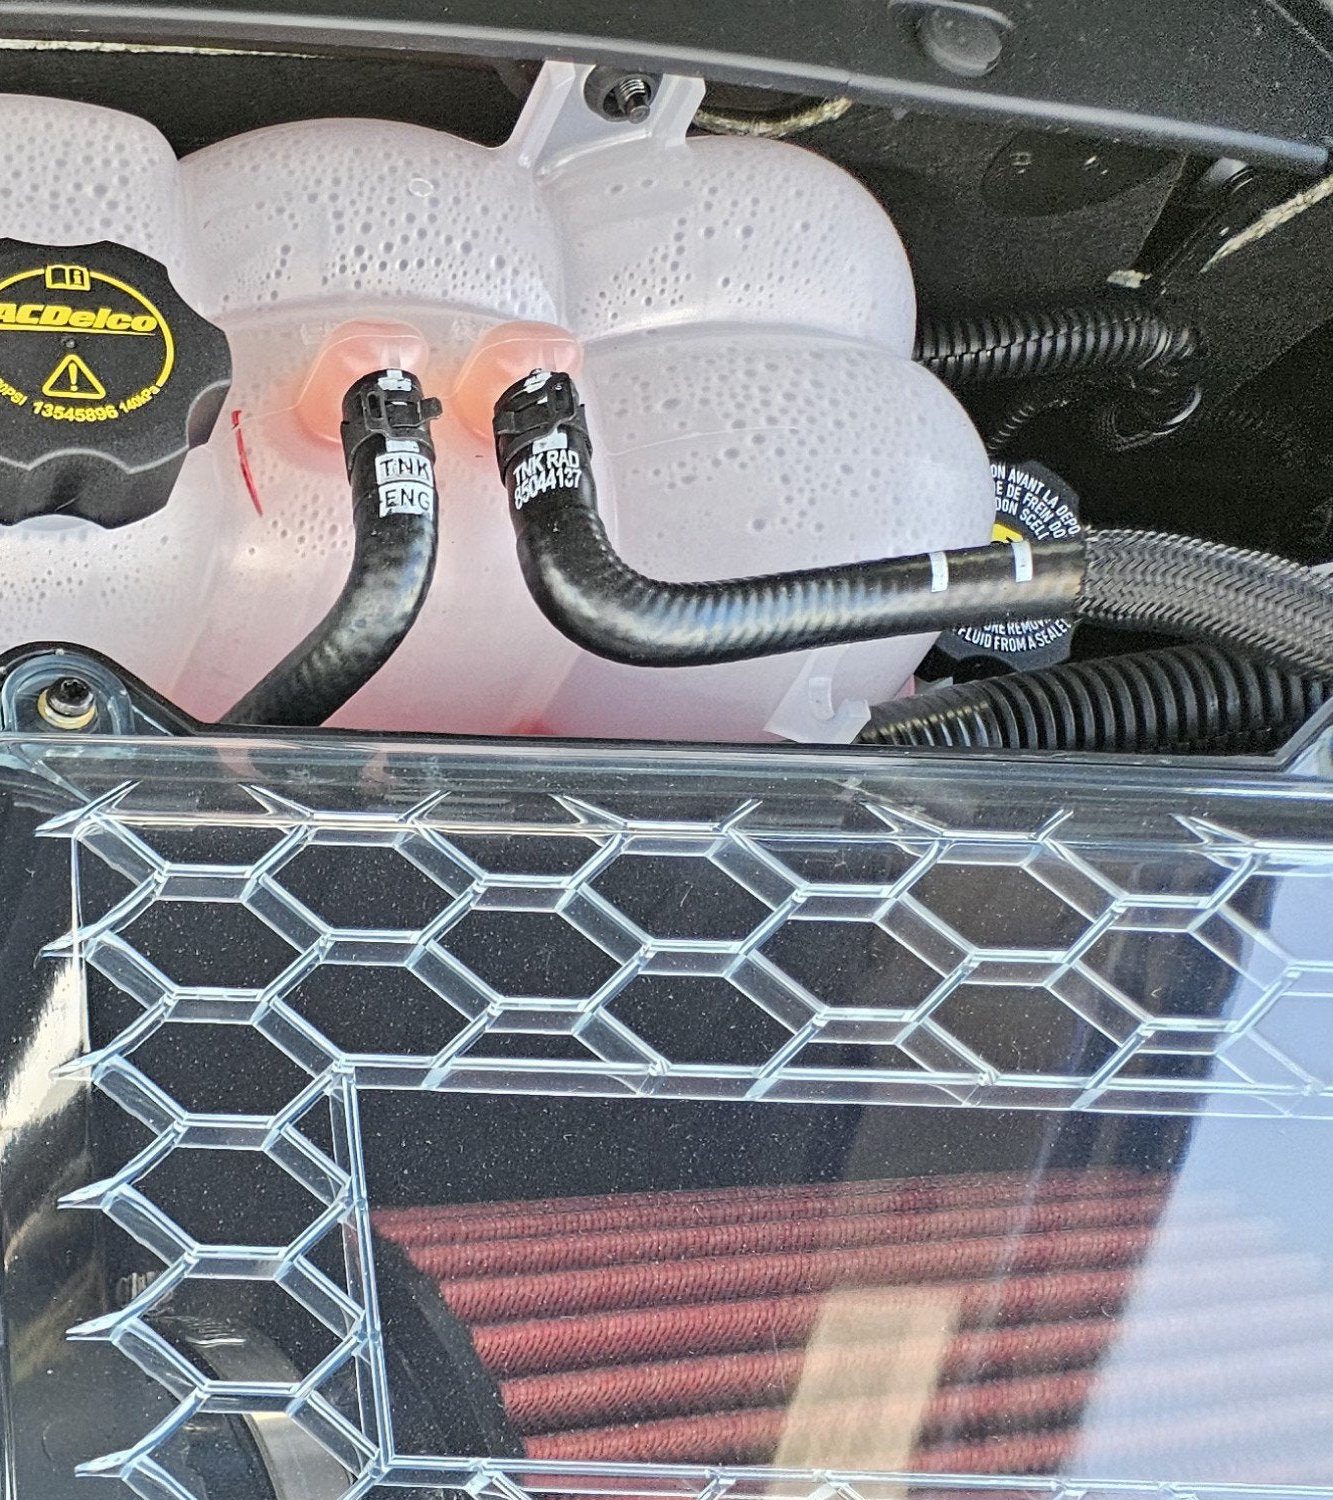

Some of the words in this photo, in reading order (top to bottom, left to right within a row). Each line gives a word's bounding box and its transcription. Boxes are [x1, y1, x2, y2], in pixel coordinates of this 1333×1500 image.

[32, 401, 119, 422] 13545896
[379, 458, 431, 481] TNK
[513, 453, 544, 486] TNK
[546, 449, 580, 469] RAD
[1007, 468, 1045, 494] AVANT
[1042, 489, 1059, 509] LA
[384, 489, 431, 512] ENG
[1006, 483, 1022, 500] DE
[1022, 492, 1055, 523] FREIN
[1048, 520, 1067, 539] DO
[994, 635, 1027, 652] FROM
[1028, 636, 1037, 650] A
